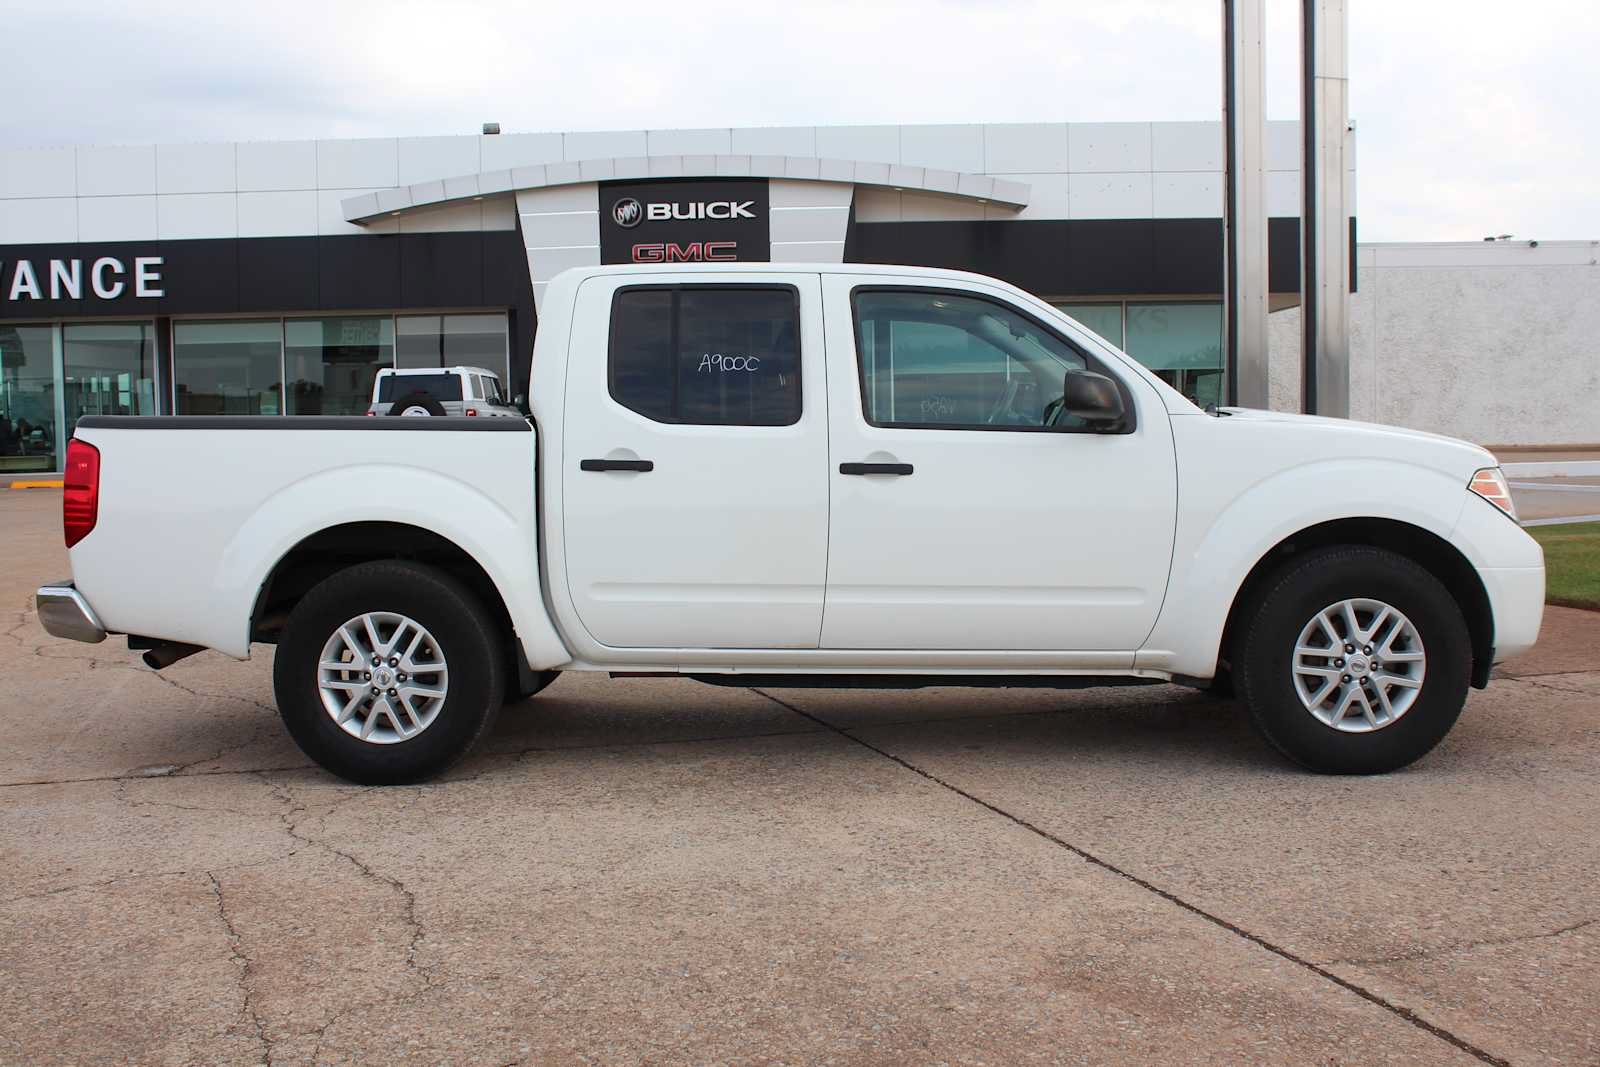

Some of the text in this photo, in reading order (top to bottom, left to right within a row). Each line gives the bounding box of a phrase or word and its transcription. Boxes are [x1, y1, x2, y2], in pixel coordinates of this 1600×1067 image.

[647, 200, 757, 221] BUICK
[631, 242, 738, 263] GMC
[0, 256, 165, 300] ANCE
